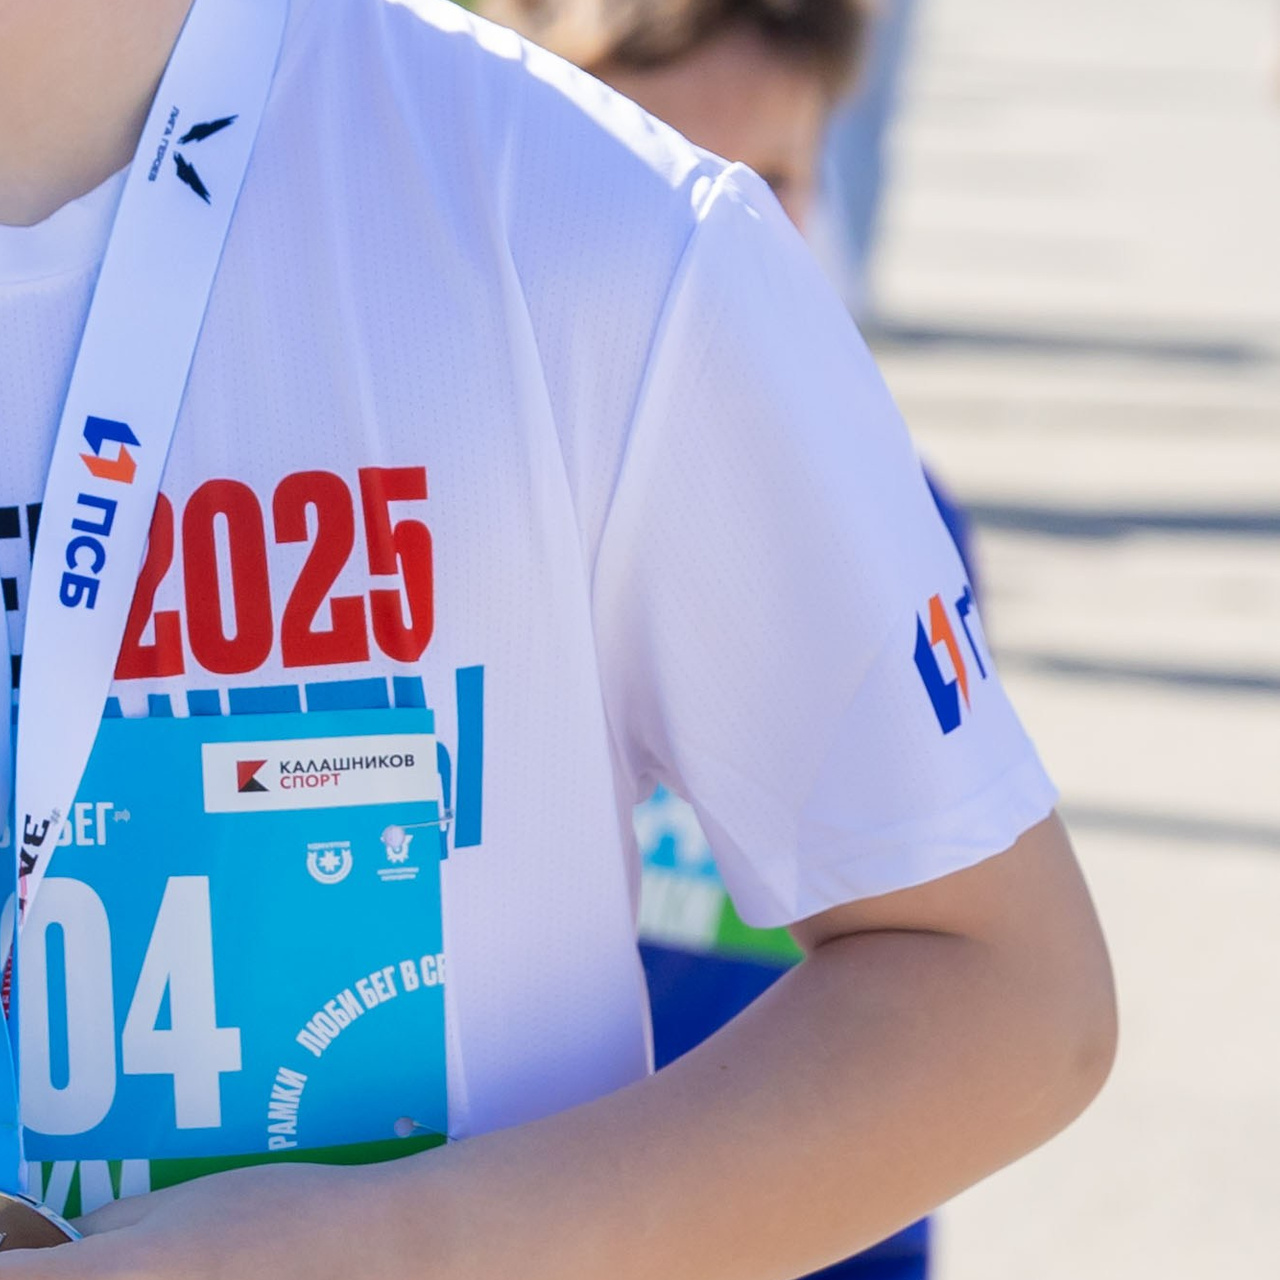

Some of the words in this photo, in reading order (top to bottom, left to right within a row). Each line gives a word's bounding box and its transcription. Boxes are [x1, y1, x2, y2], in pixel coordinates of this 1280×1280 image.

[59, 492, 118, 610] ПСБ
[279, 754, 416, 775] КАЛАШНИКОВ
[279, 773, 342, 790] СПОРТ
[295, 988, 365, 1058] ЛЮБИ
[355, 965, 398, 1010] БЕГ
[399, 959, 420, 993] В
[267, 1066, 308, 1151] РАМКИ
